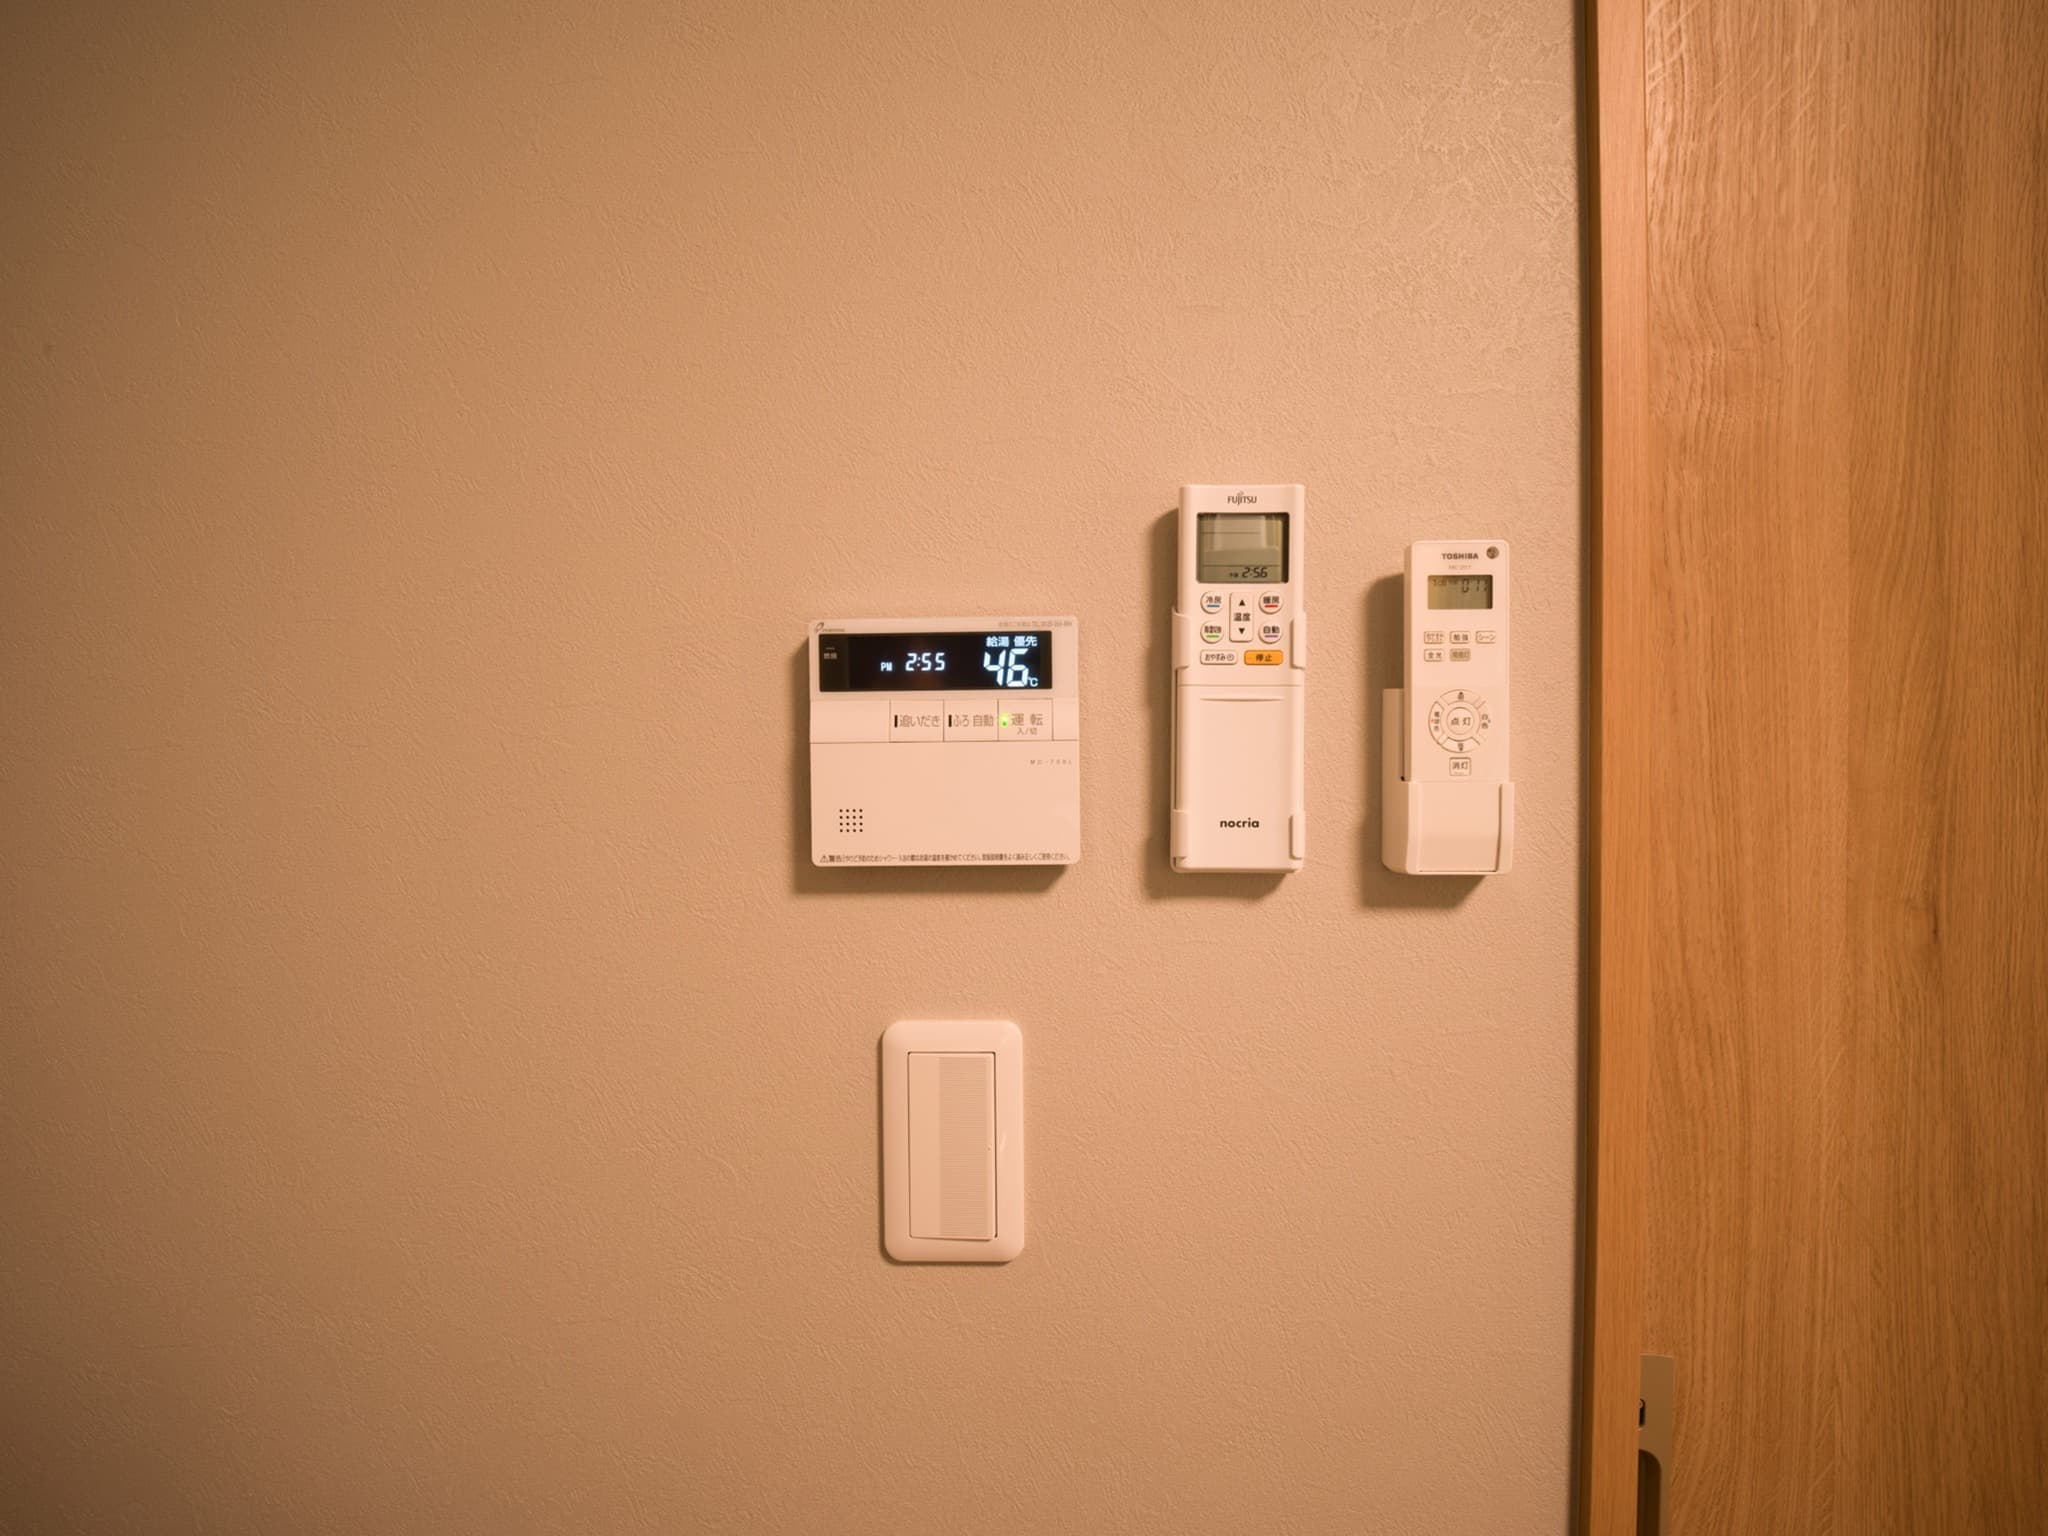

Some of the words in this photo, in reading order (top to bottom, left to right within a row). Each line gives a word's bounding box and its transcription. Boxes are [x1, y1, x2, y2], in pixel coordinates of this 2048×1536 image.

[1227, 495, 1257, 505] FUJITSU
[1242, 567, 1268, 578] 2:56
[986, 636, 1010, 648] 給湯
[1014, 635, 1038, 647] 優先
[904, 652, 946, 672] 2:55
[1255, 653, 1273, 662] 停止
[880, 662, 893, 672] PM
[900, 714, 940, 728] 追いだき
[953, 715, 970, 728] ふろ
[973, 714, 994, 728] 自動
[1451, 717, 1471, 726] 点灯
[1219, 817, 1260, 828] nocria
